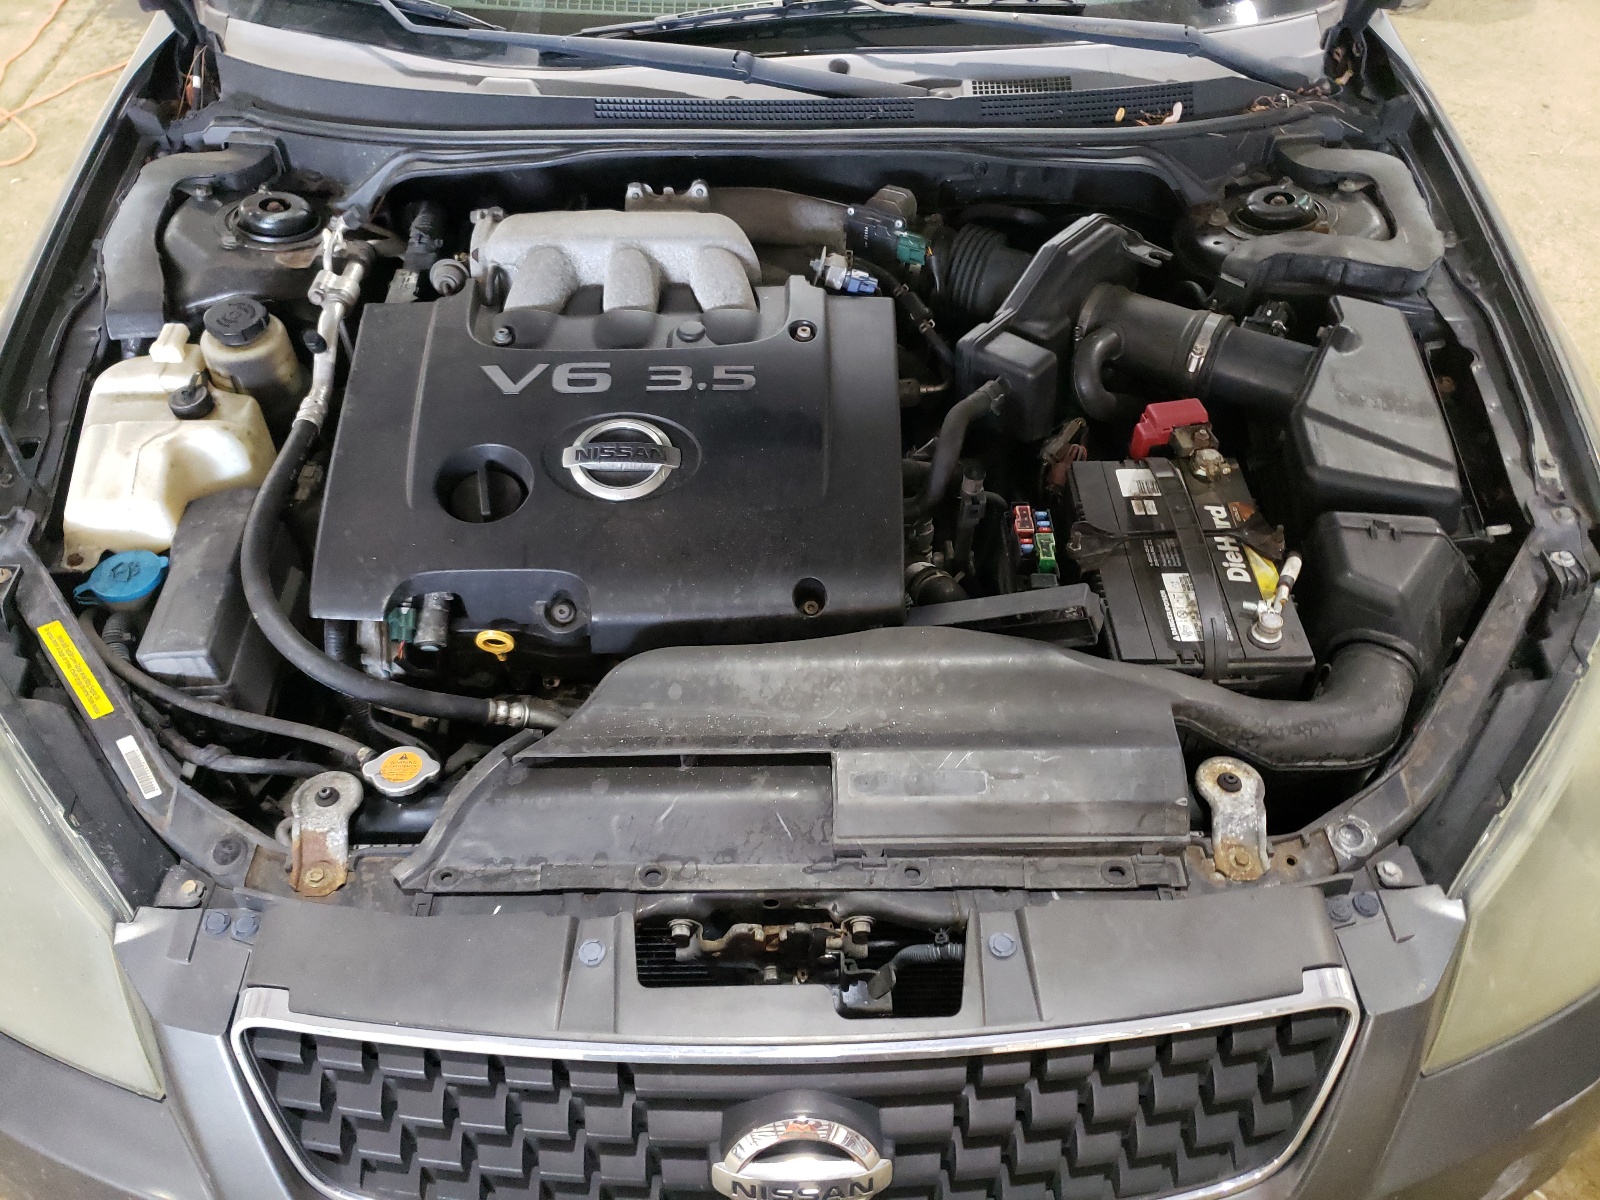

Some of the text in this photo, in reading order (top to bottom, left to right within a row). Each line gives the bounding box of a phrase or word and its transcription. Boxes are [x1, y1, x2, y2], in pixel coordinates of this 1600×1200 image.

[479, 361, 757, 395] V6 3.5
[574, 446, 667, 461] NISSAN
[1203, 504, 1253, 583] DieHrd
[731, 1177, 874, 1200] NISSAN
